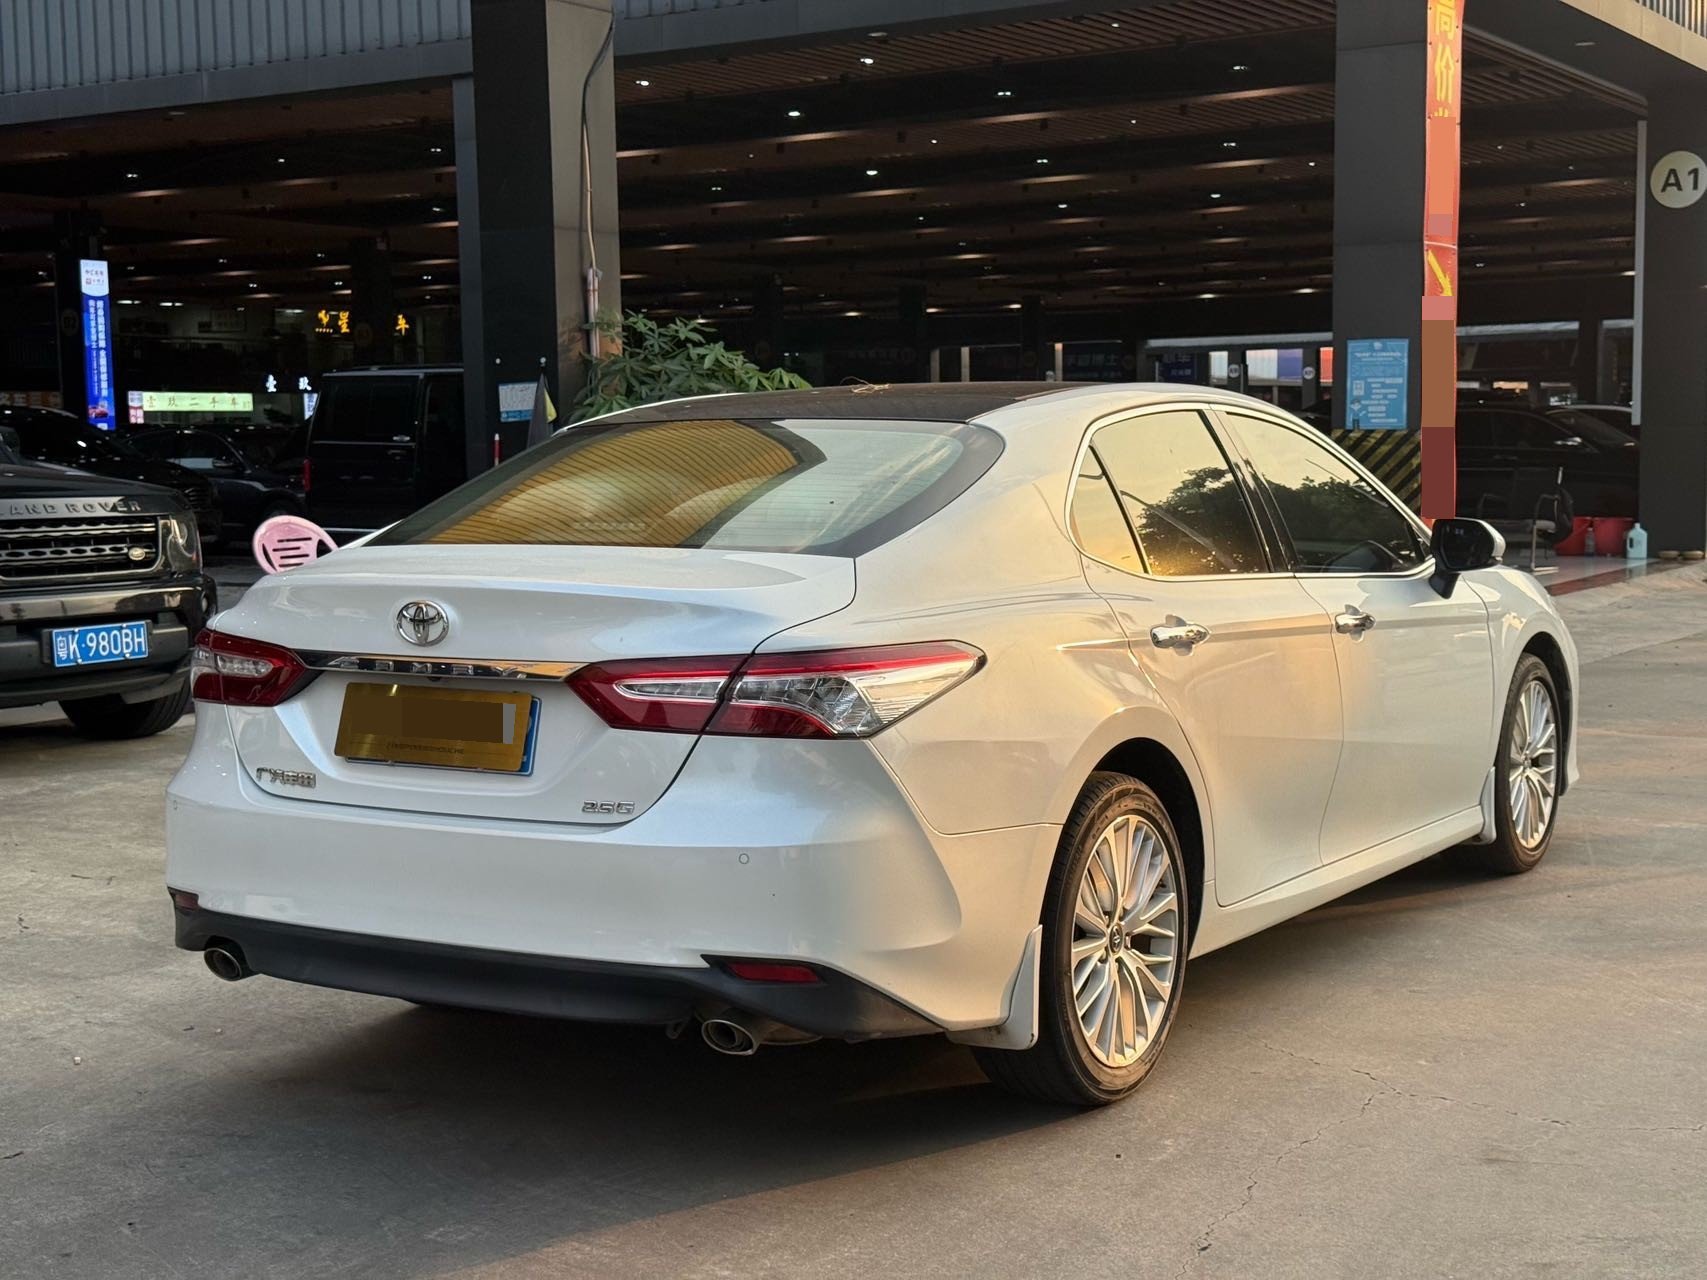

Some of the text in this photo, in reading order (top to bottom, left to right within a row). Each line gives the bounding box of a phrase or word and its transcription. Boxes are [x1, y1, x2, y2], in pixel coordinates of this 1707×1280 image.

[1660, 167, 1699, 193] A1
[0, 500, 141, 516] AND ROVER
